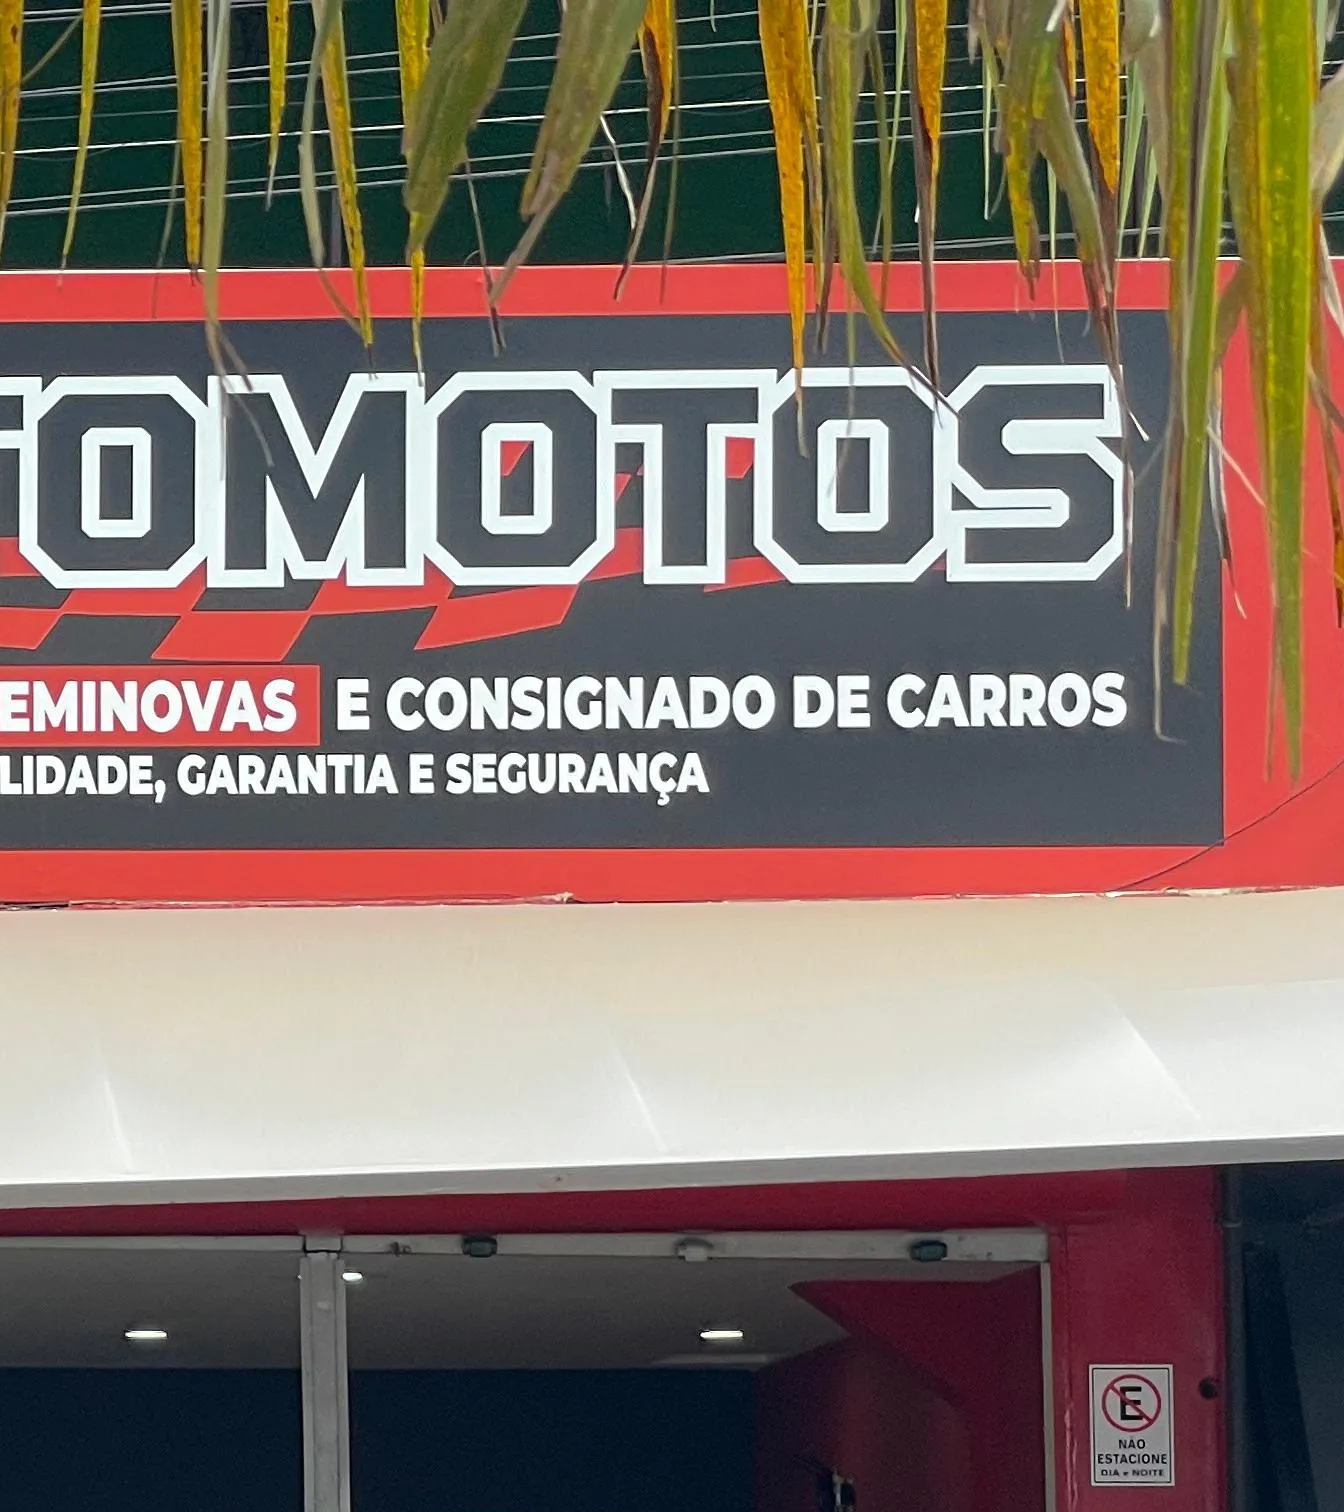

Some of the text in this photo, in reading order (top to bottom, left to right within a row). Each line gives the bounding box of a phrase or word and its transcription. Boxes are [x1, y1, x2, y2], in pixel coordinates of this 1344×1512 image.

[335, 677, 372, 732] E
[385, 673, 778, 733] CONSIGNADO
[792, 673, 872, 730] DE
[885, 671, 1129, 730] CARROS
[176, 752, 397, 797] GARANTIA
[408, 752, 436, 795] E
[444, 750, 712, 807] SEGURANÇA
[1120, 1386, 1144, 1421] E
[1097, 1453, 1168, 1465] ESTACIONE
[1101, 1469, 1120, 1477] DIA
[1132, 1469, 1165, 1477] NOITE
